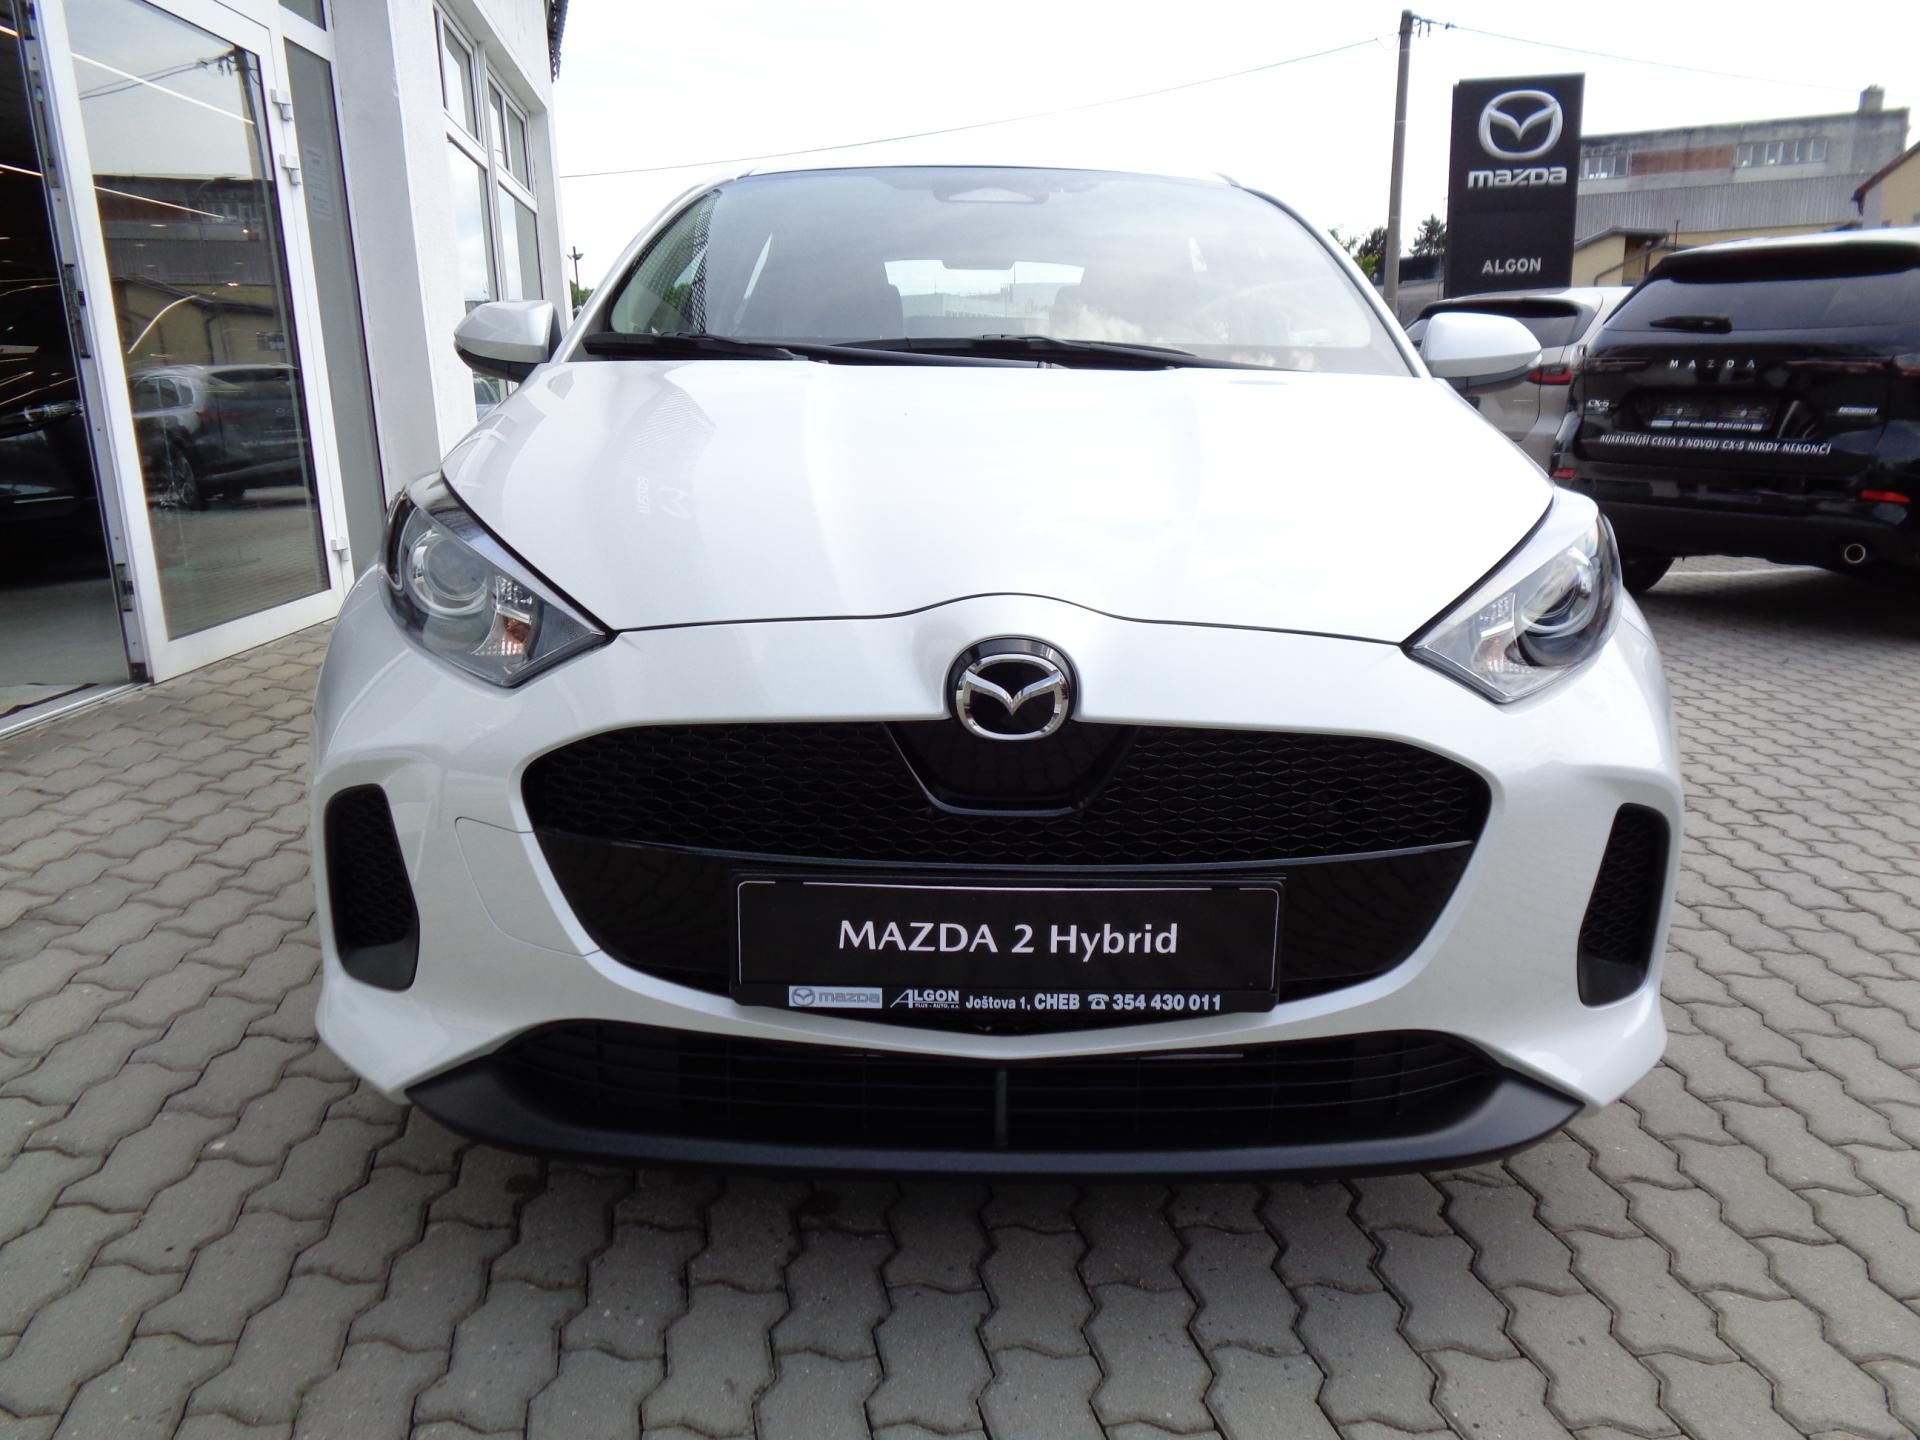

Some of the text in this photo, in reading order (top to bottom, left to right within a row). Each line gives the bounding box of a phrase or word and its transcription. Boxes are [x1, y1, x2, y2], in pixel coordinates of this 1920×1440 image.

[1467, 167, 1567, 189] mazda
[1481, 258, 1541, 275] ALGON
[1669, 359, 1755, 369] MAZDA
[1587, 399, 1610, 407] CX-5
[1652, 436, 1676, 447] CESTA
[1678, 438, 1685, 448] S
[1686, 438, 1719, 449] NOVOU
[1722, 439, 1745, 449] CX-5
[1747, 440, 1780, 452] NIKDY
[1782, 442, 1832, 455] NEKONČÍ
[838, 920, 1178, 962] MAZDA 2 Hybrid
[889, 988, 960, 1009] ALGON
[966, 993, 1221, 1011] Joštova 1, CHEB 354 430 011
